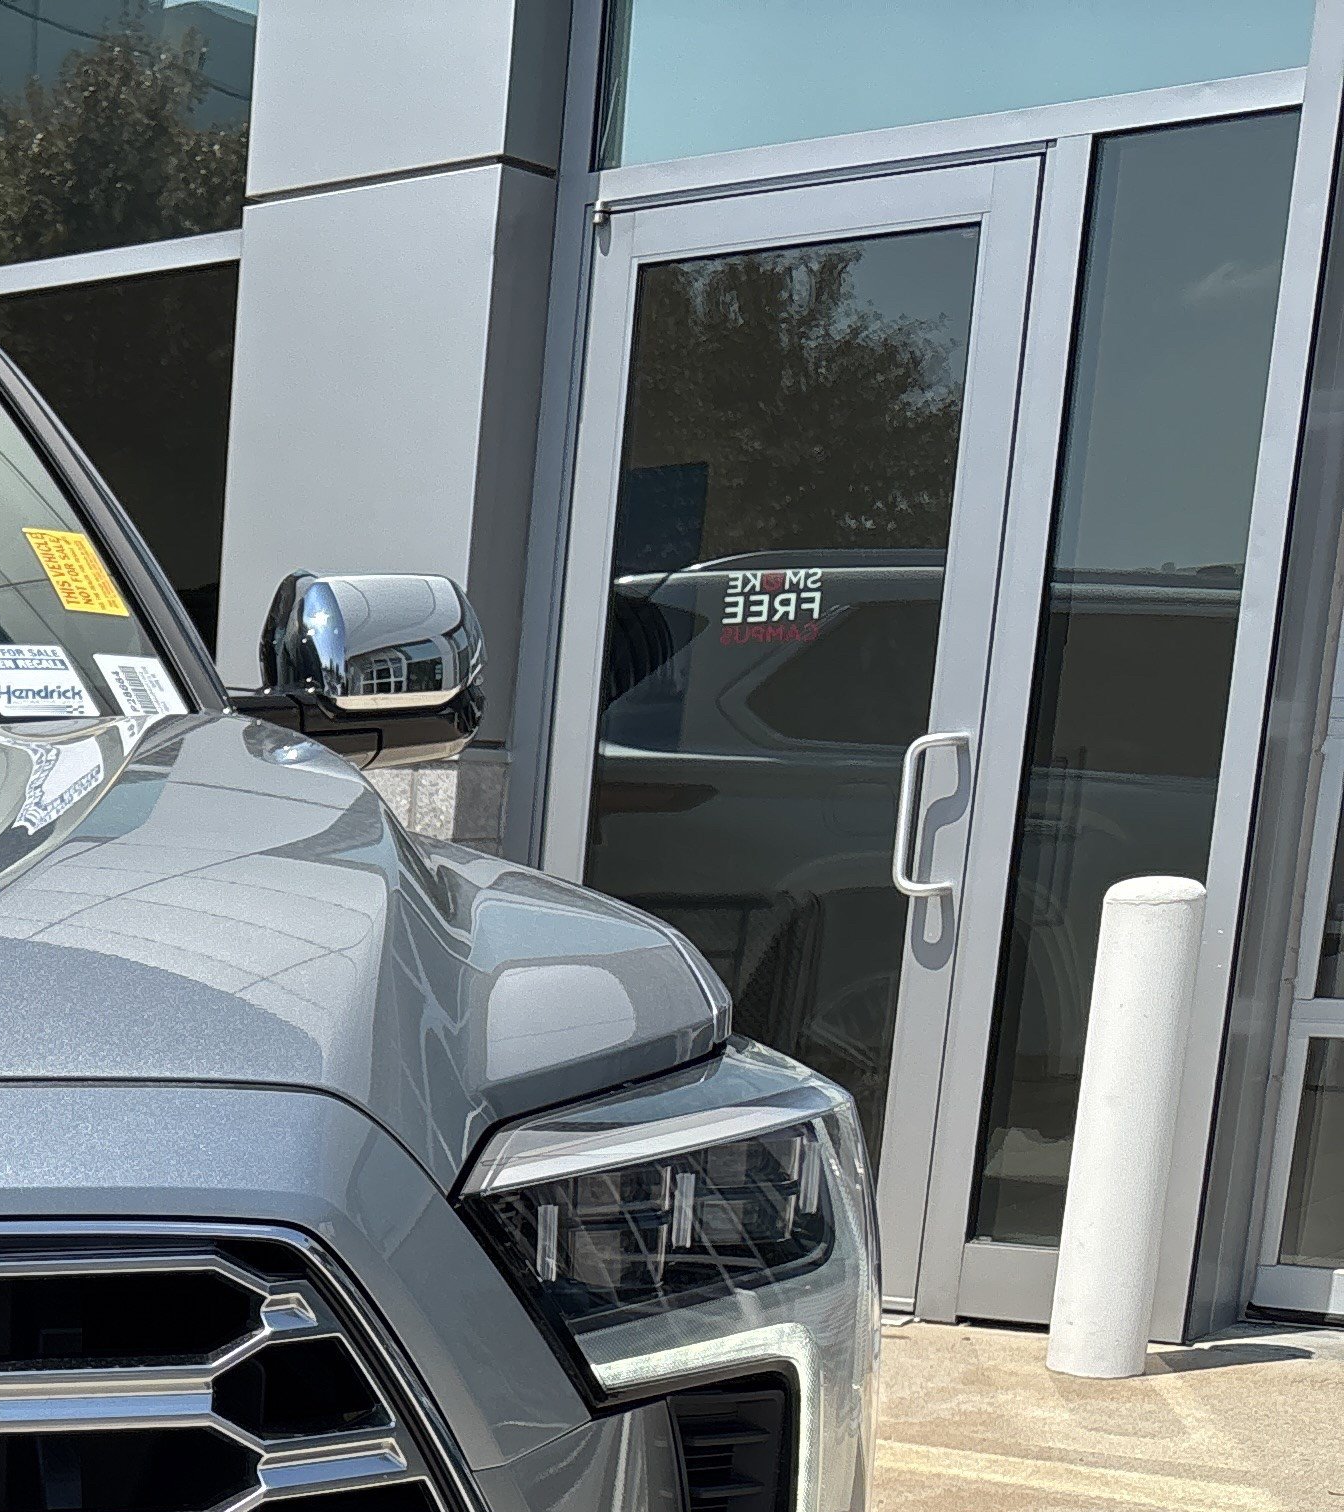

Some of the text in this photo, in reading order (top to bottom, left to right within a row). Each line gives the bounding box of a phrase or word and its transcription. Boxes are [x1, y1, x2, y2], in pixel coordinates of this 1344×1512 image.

[49, 537, 71, 561] SALE
[31, 532, 81, 605] THIS VEHICLE
[64, 563, 82, 583] FOR
[75, 585, 94, 606] NOT
[0, 648, 25, 658] FOR
[27, 648, 61, 658] SALE
[17, 659, 65, 669] RECALL
